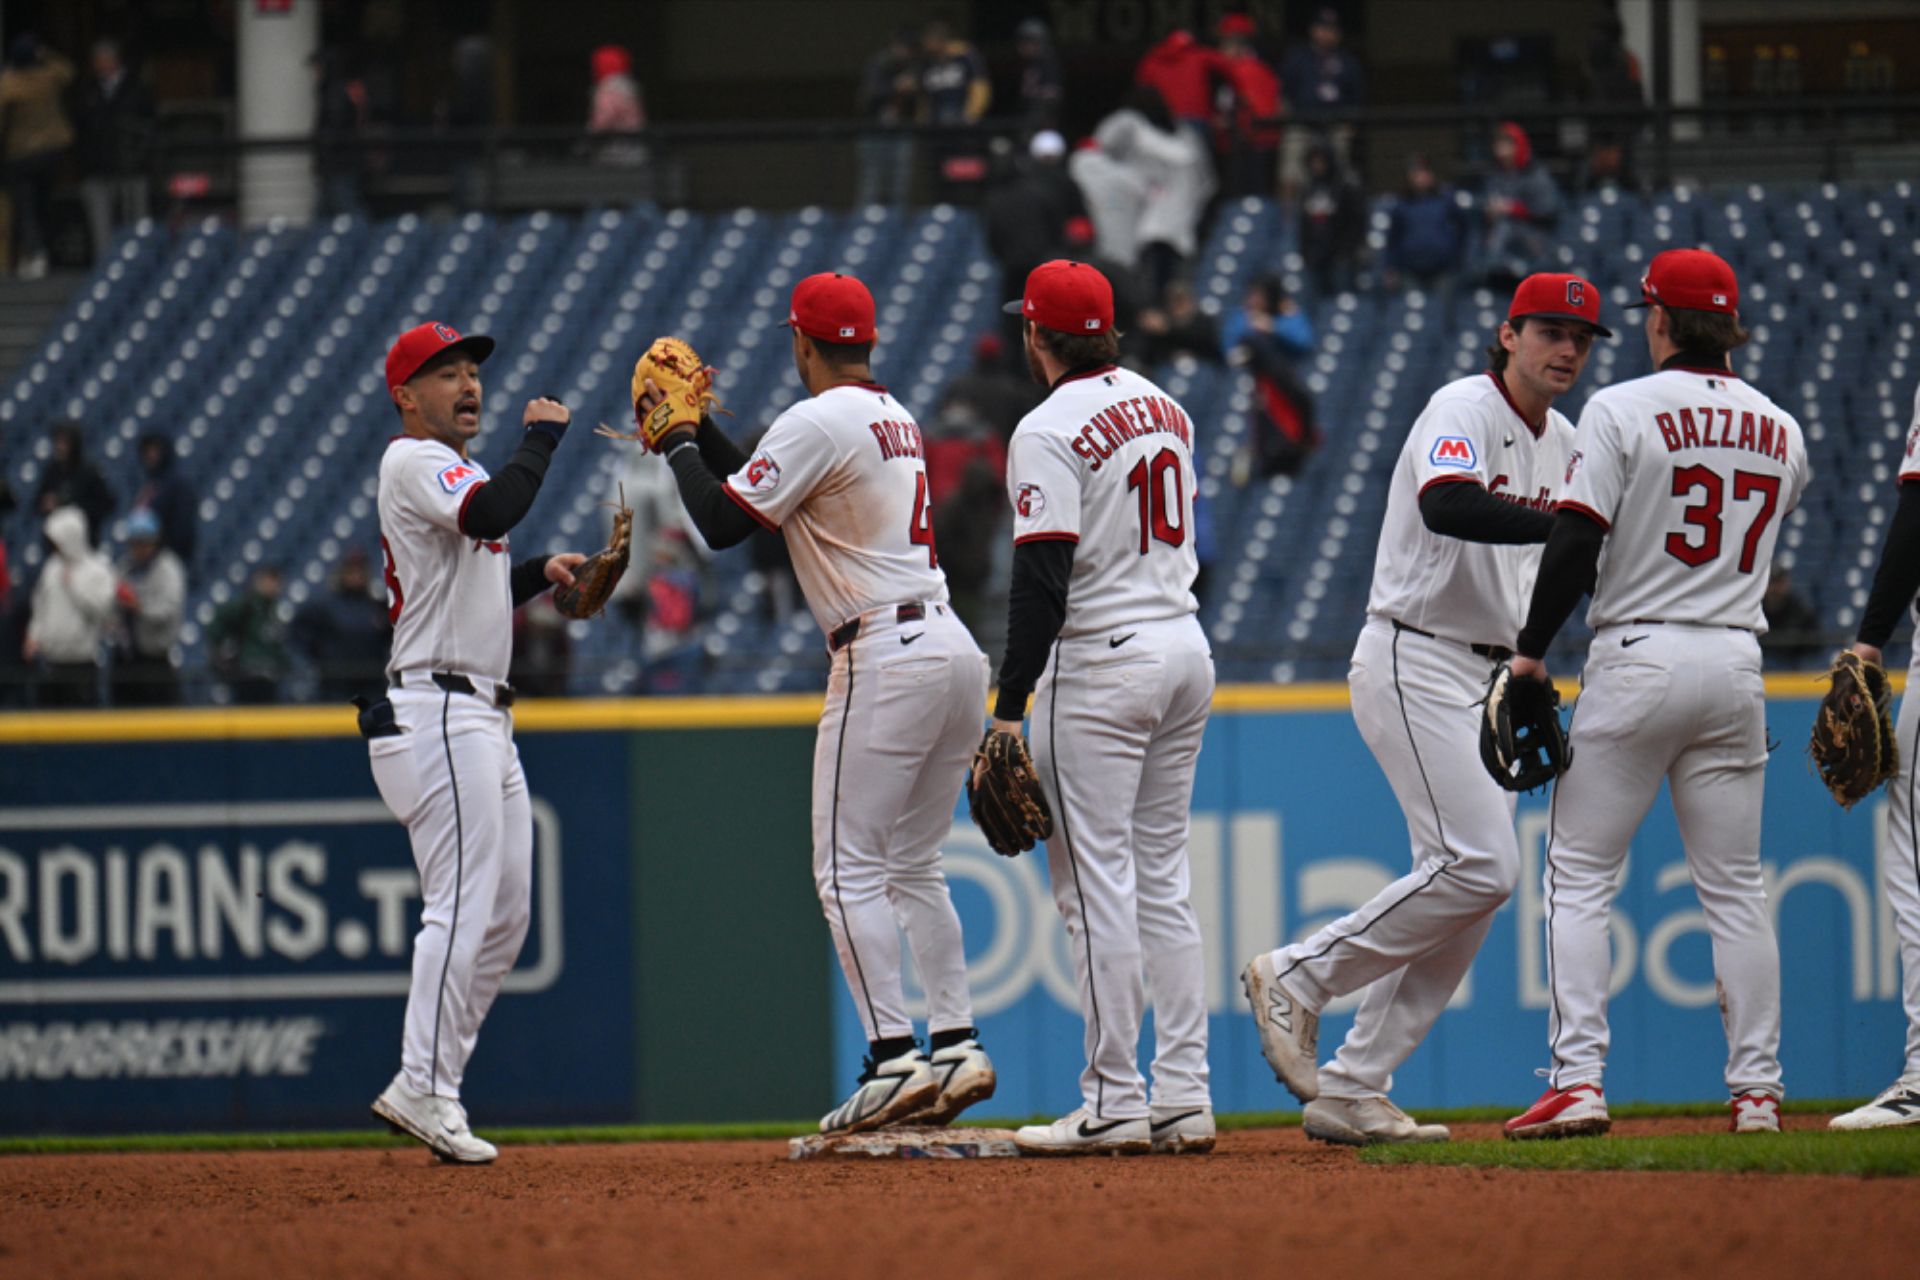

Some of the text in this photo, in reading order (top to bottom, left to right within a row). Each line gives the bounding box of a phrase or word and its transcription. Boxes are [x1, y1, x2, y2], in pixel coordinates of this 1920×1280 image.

[1567, 280, 1584, 305] C
[433, 322, 456, 341] C
[1438, 440, 1469, 458] M
[1655, 406, 1788, 465] BAZZANA
[444, 465, 473, 486] M
[1127, 446, 1185, 556] 10
[1663, 463, 1782, 575] 37
[897, 812, 1512, 1018] Dlla
